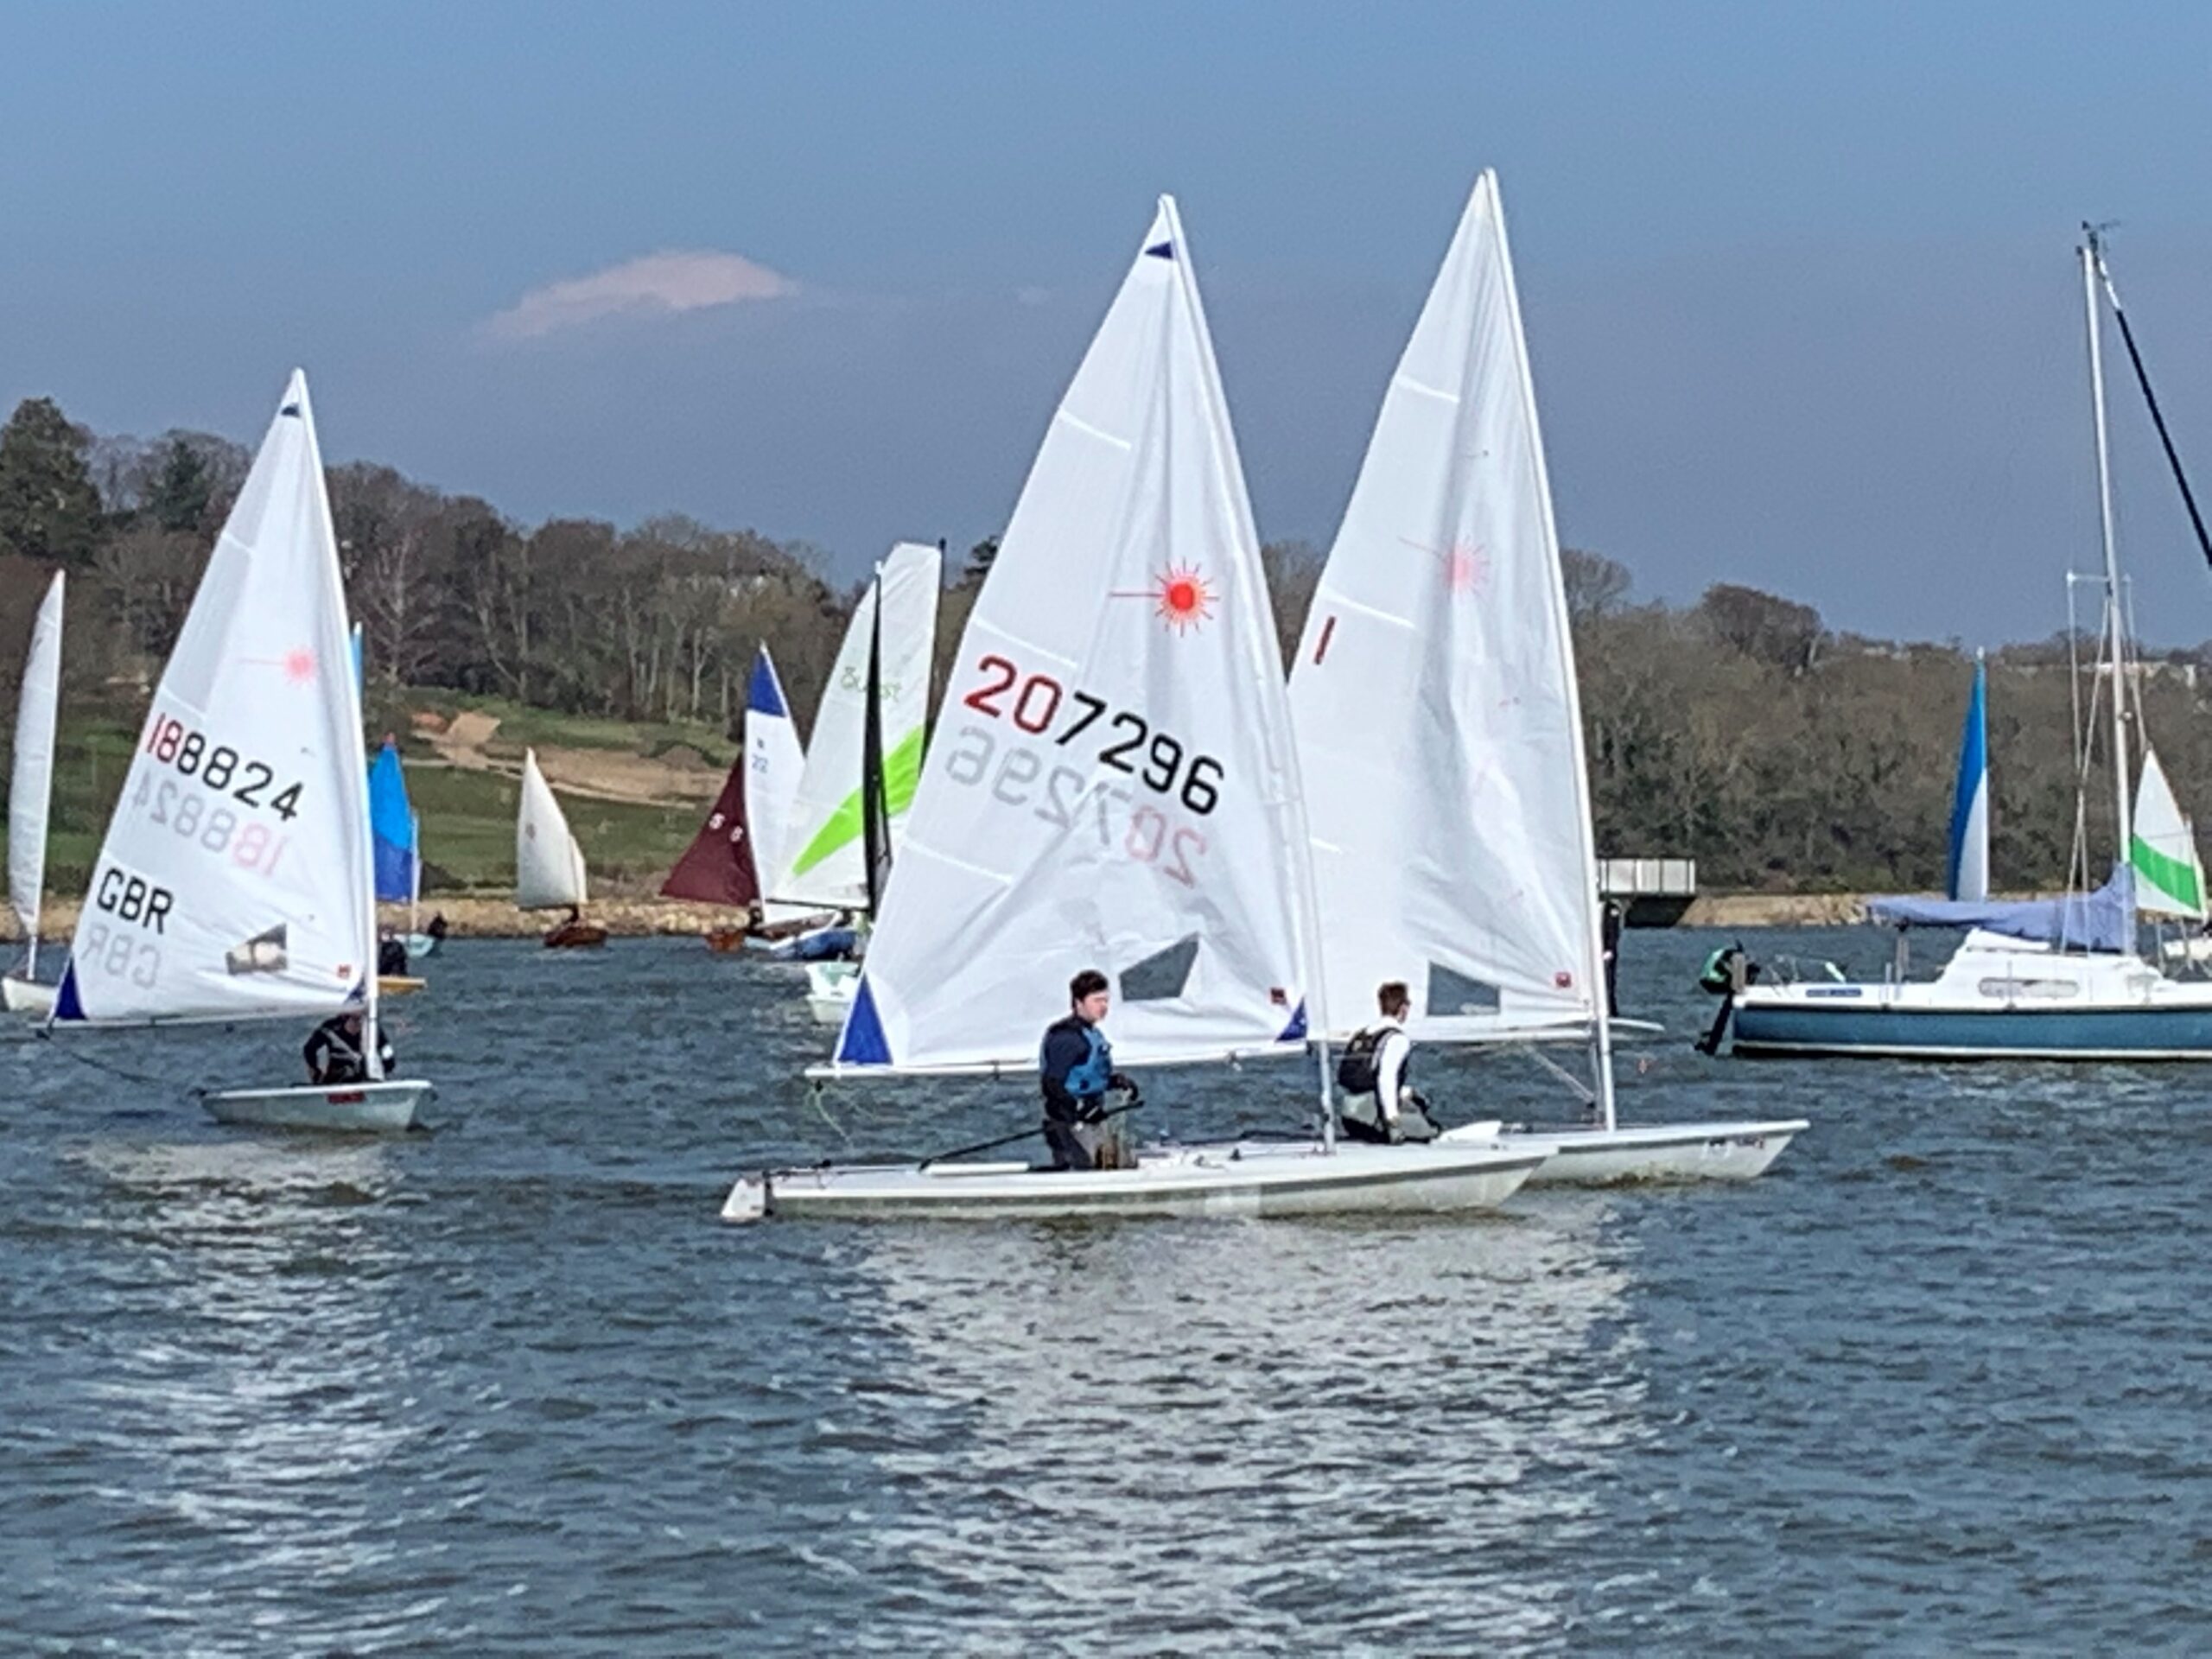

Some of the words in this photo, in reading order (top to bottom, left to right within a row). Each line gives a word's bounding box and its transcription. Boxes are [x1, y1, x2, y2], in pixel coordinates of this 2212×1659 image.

[146, 712, 303, 822] 188824
[963, 655, 1224, 815] 207296
[96, 867, 174, 935] GBR
